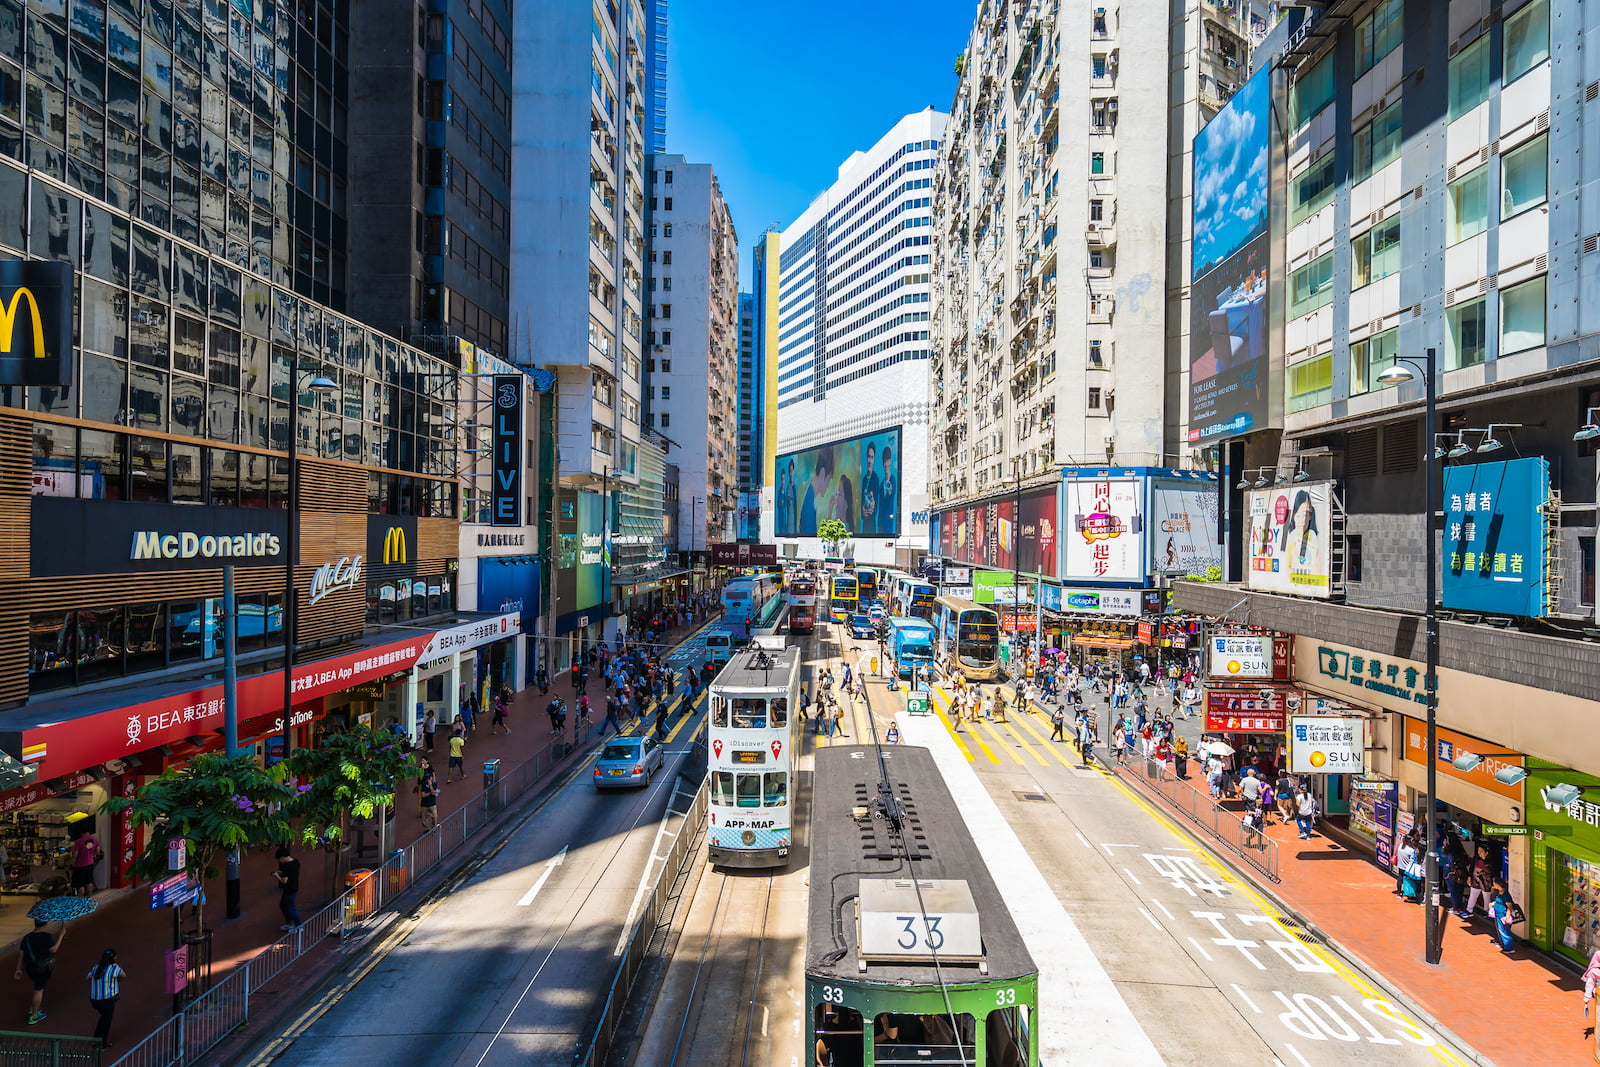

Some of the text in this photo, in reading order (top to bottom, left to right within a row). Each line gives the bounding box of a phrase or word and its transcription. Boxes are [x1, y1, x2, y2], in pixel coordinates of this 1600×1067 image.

[1203, 379, 1217, 391] LEASE
[497, 414, 517, 518] LIVE
[1094, 481, 1111, 513] 同心
[1450, 491, 1492, 512] 為讀者
[1450, 522, 1477, 542] 找書
[130, 531, 281, 560] McDonald's
[1093, 544, 1110, 577] 起步
[1450, 551, 1524, 574] 為書找讀者
[440, 636, 454, 650] BEA
[454, 634, 467, 647] App
[337, 667, 353, 680] App
[1242, 661, 1269, 670] SUN
[146, 709, 182, 733] BEA
[1329, 751, 1361, 762] SUN
[895, 916, 944, 950] 33
[822, 986, 844, 1004] 33
[995, 988, 1016, 1006] 33
[1271, 990, 1437, 1047] STOP
